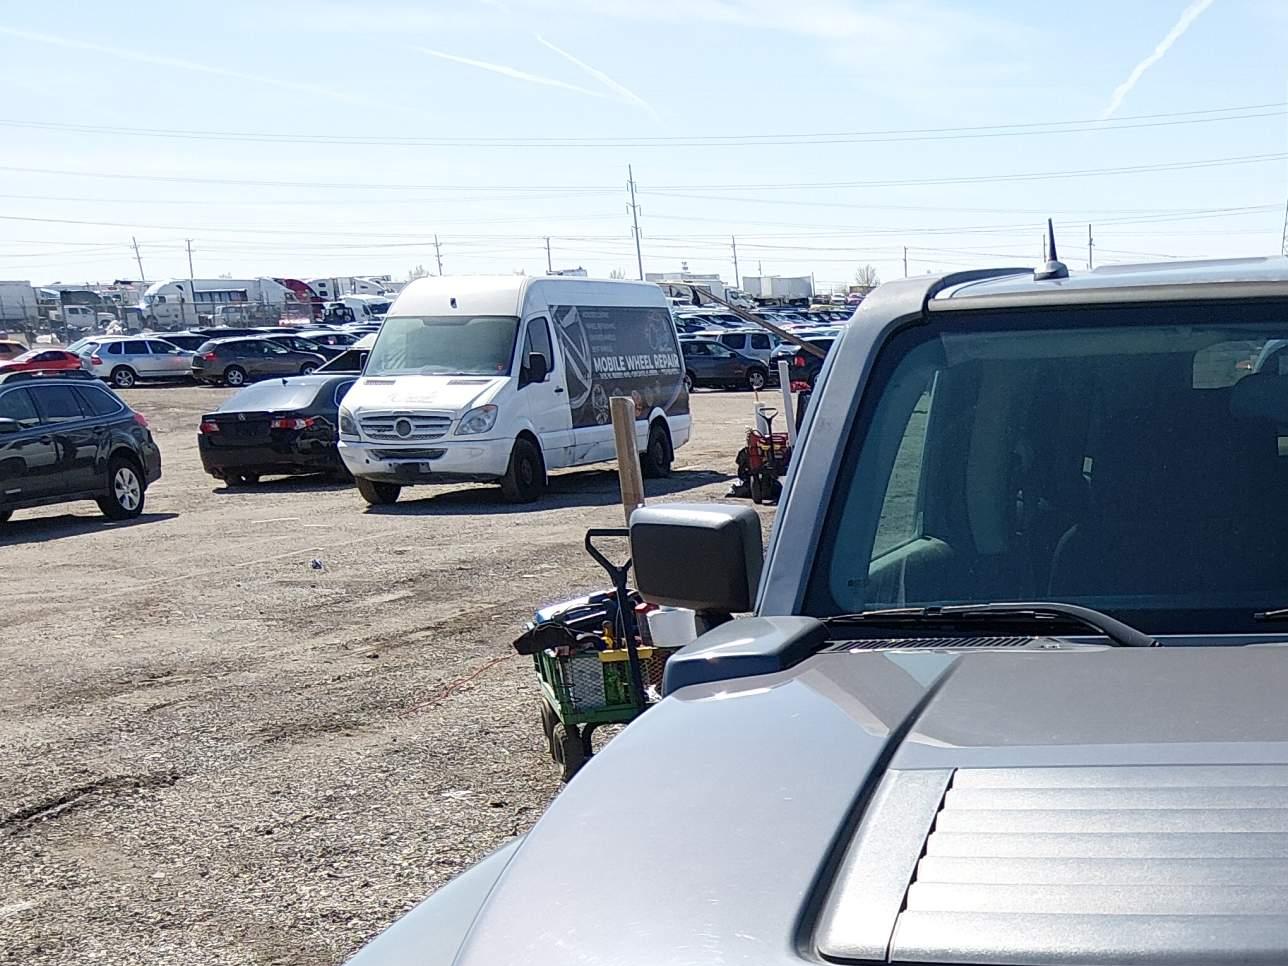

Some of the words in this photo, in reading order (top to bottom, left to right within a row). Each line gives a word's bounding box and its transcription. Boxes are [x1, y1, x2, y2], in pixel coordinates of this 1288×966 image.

[593, 356, 625, 372] MOBILE
[625, 355, 654, 370] WHEEL
[654, 353, 680, 368] REPAIR
